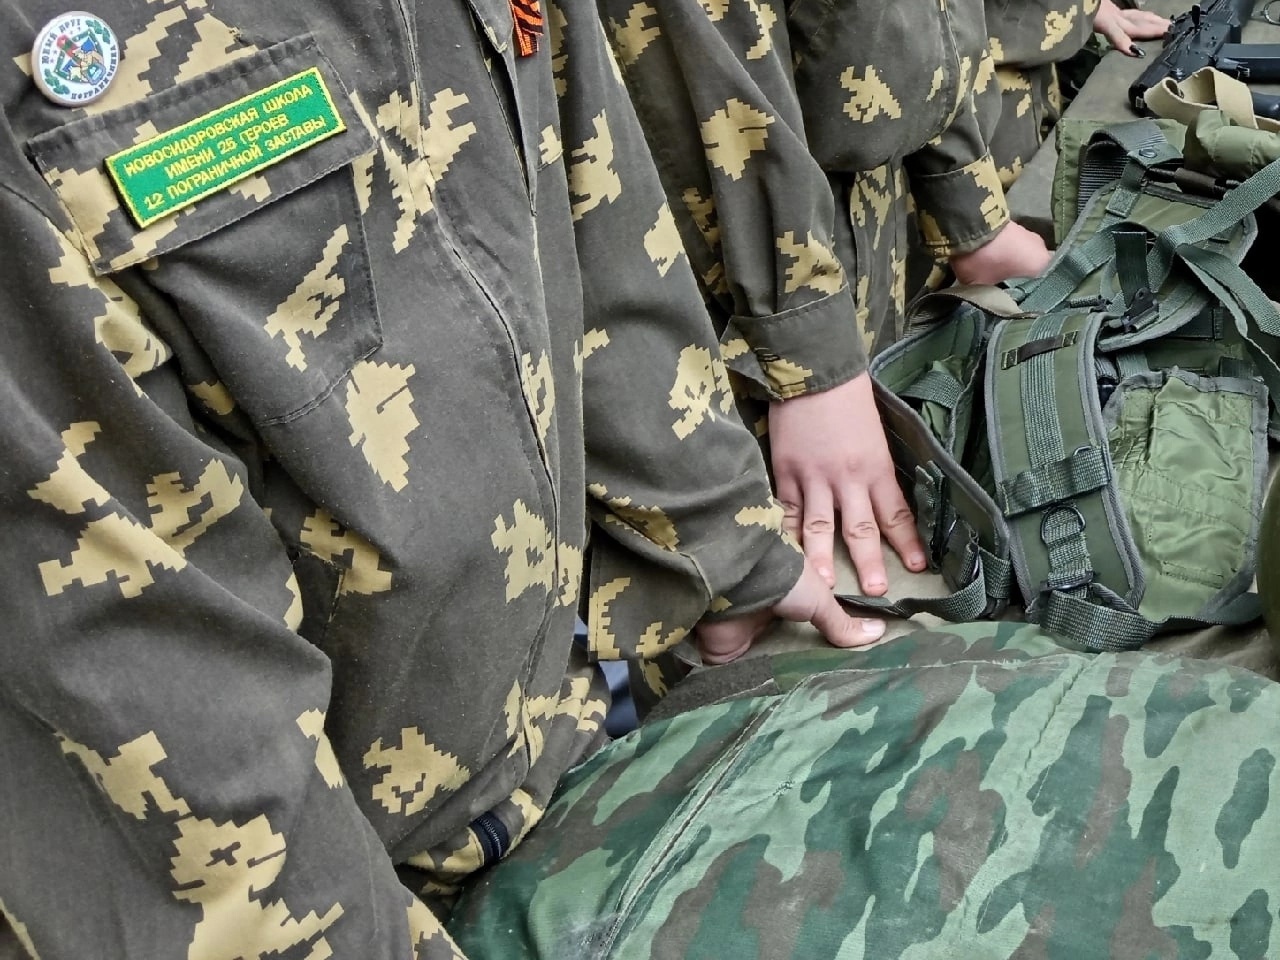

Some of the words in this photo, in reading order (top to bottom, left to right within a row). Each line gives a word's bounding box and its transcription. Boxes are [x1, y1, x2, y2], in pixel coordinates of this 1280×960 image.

[41, 32, 57, 64] ЮНЫЙ
[123, 108, 258, 177] НОВОСИДОРОВСКАЯ
[262, 84, 313, 114] ШКОЛА
[144, 193, 165, 211] 12
[166, 142, 263, 199] ПОГРАНИЧНОЙ
[264, 115, 326, 151] ЗАСТАВЫ
[164, 147, 215, 180] ИМЕНИ
[217, 137, 237, 155] 25
[239, 114, 289, 145] ГЕРОЕВ
